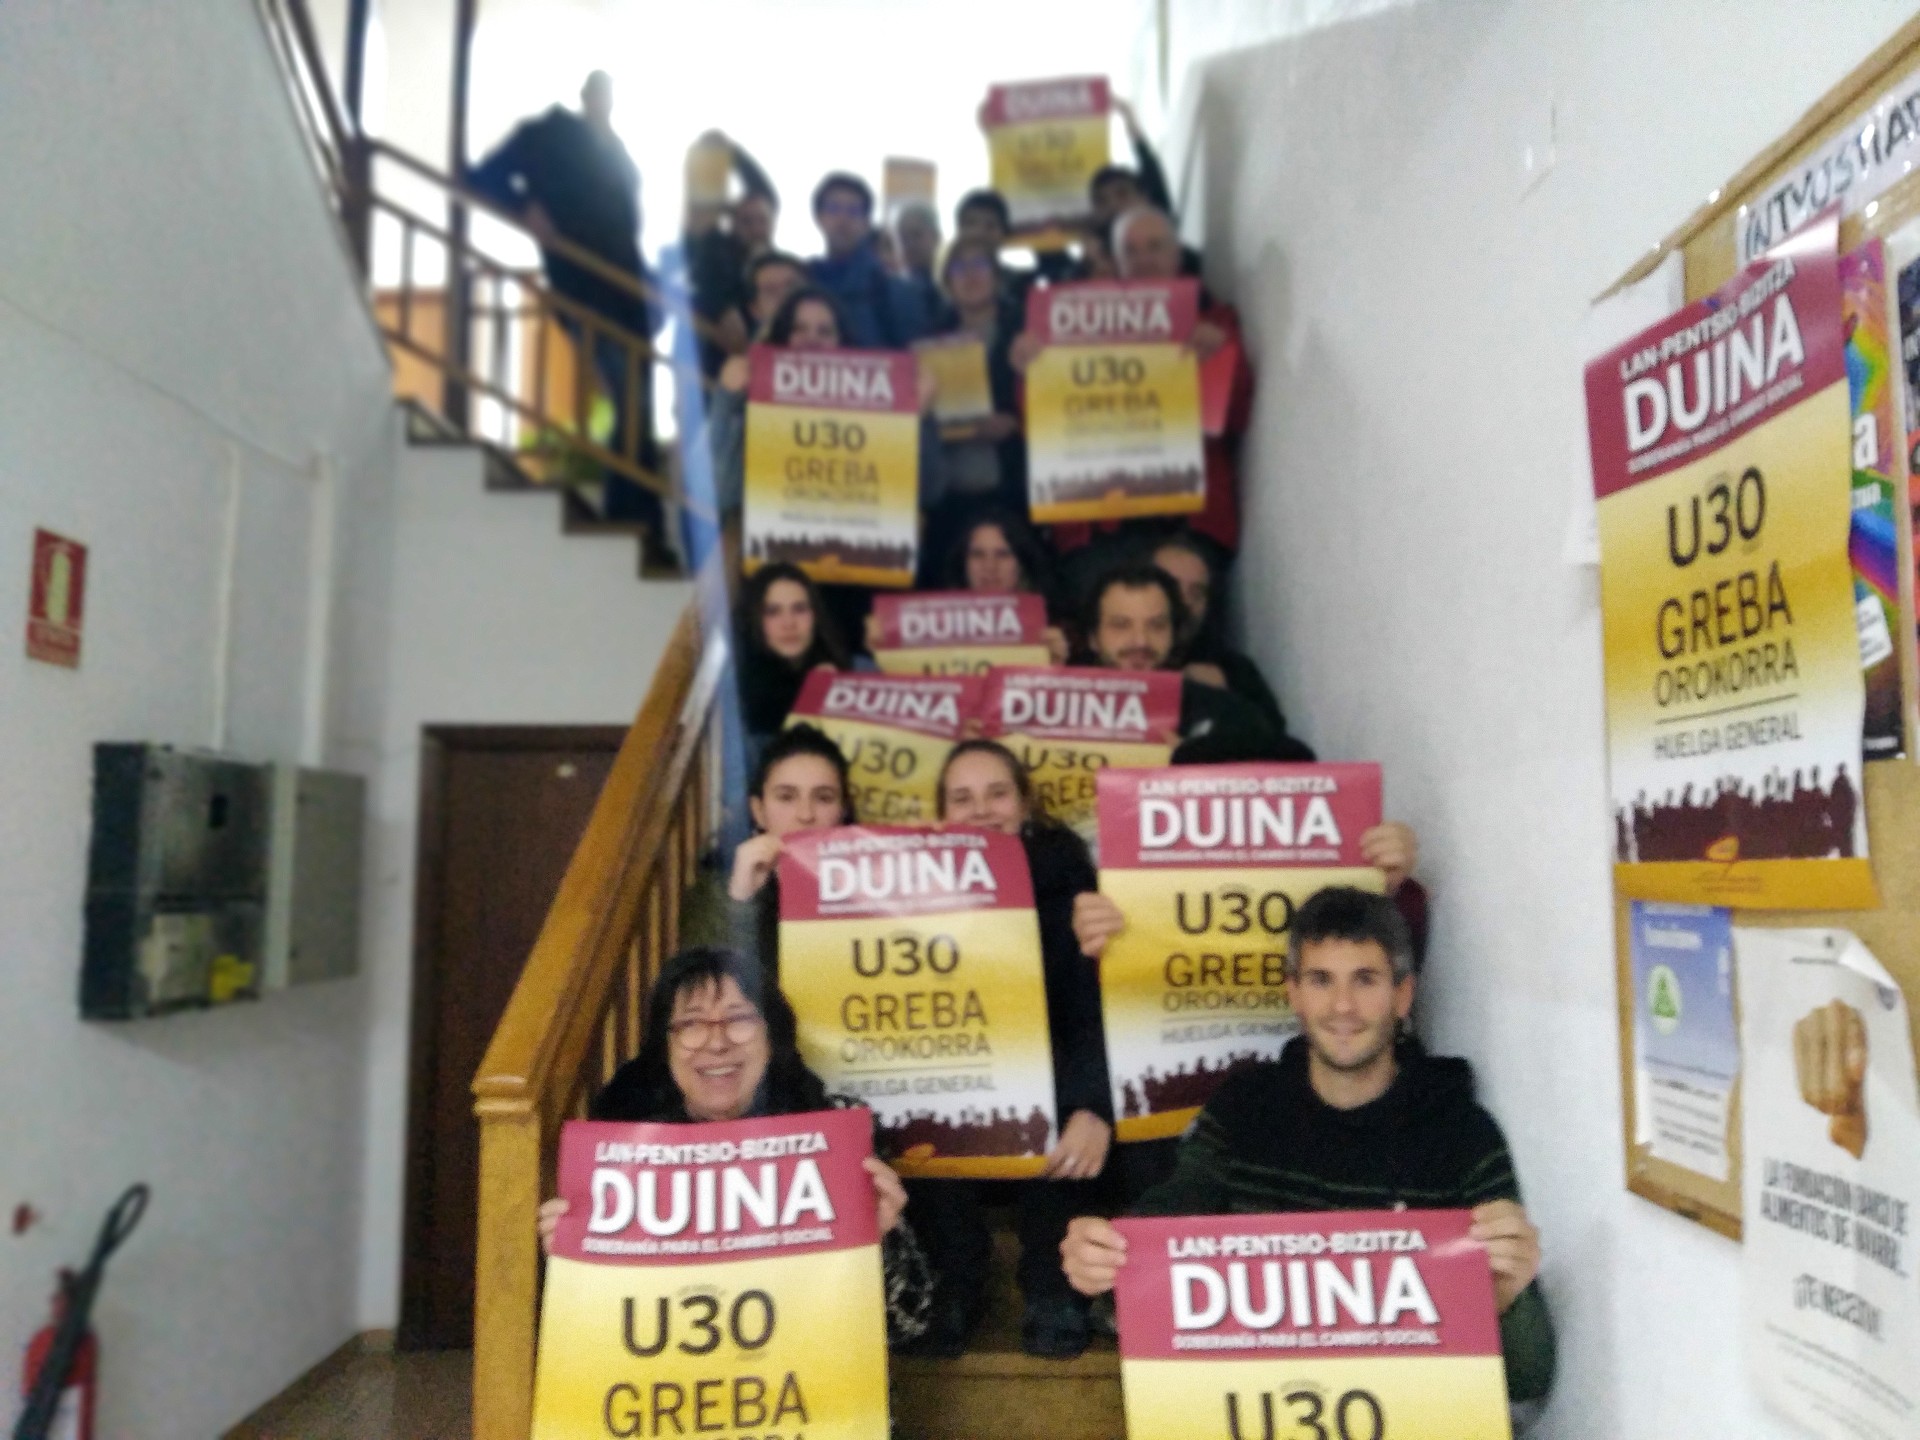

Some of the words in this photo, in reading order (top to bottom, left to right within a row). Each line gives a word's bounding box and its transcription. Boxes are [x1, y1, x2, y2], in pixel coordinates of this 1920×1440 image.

[1051, 298, 1171, 338] DUINA
[773, 362, 894, 402] DUINA
[1071, 355, 1145, 387] U30
[1623, 291, 1805, 453] DUINA
[793, 418, 867, 453] U30
[1667, 465, 1766, 568] U30
[901, 607, 1023, 641] DUINA
[1655, 560, 1794, 661] GREBA
[1654, 638, 1800, 708] OROKORRA
[823, 687, 960, 726] DUINA
[1002, 689, 1149, 731] DUINA
[1139, 796, 1342, 849] DUINA
[819, 849, 997, 902] DUINA
[1176, 890, 1294, 935] U30
[851, 932, 961, 979] U30
[1164, 951, 1287, 988] GREB
[840, 989, 988, 1033] GREBA
[1162, 990, 1291, 1012] OROKOR
[841, 1032, 993, 1063] OROKORRA
[595, 1130, 830, 1166] LAN-PENTSIO-BIZITZA
[586, 1158, 837, 1236] DUINA
[1168, 1229, 1428, 1259] LAN-PENTSIO-BIZITZA
[1170, 1255, 1441, 1330] DUINA
[621, 1288, 778, 1358] U30
[603, 1370, 811, 1439] GREBA
[1224, 1388, 1386, 1440] U30
